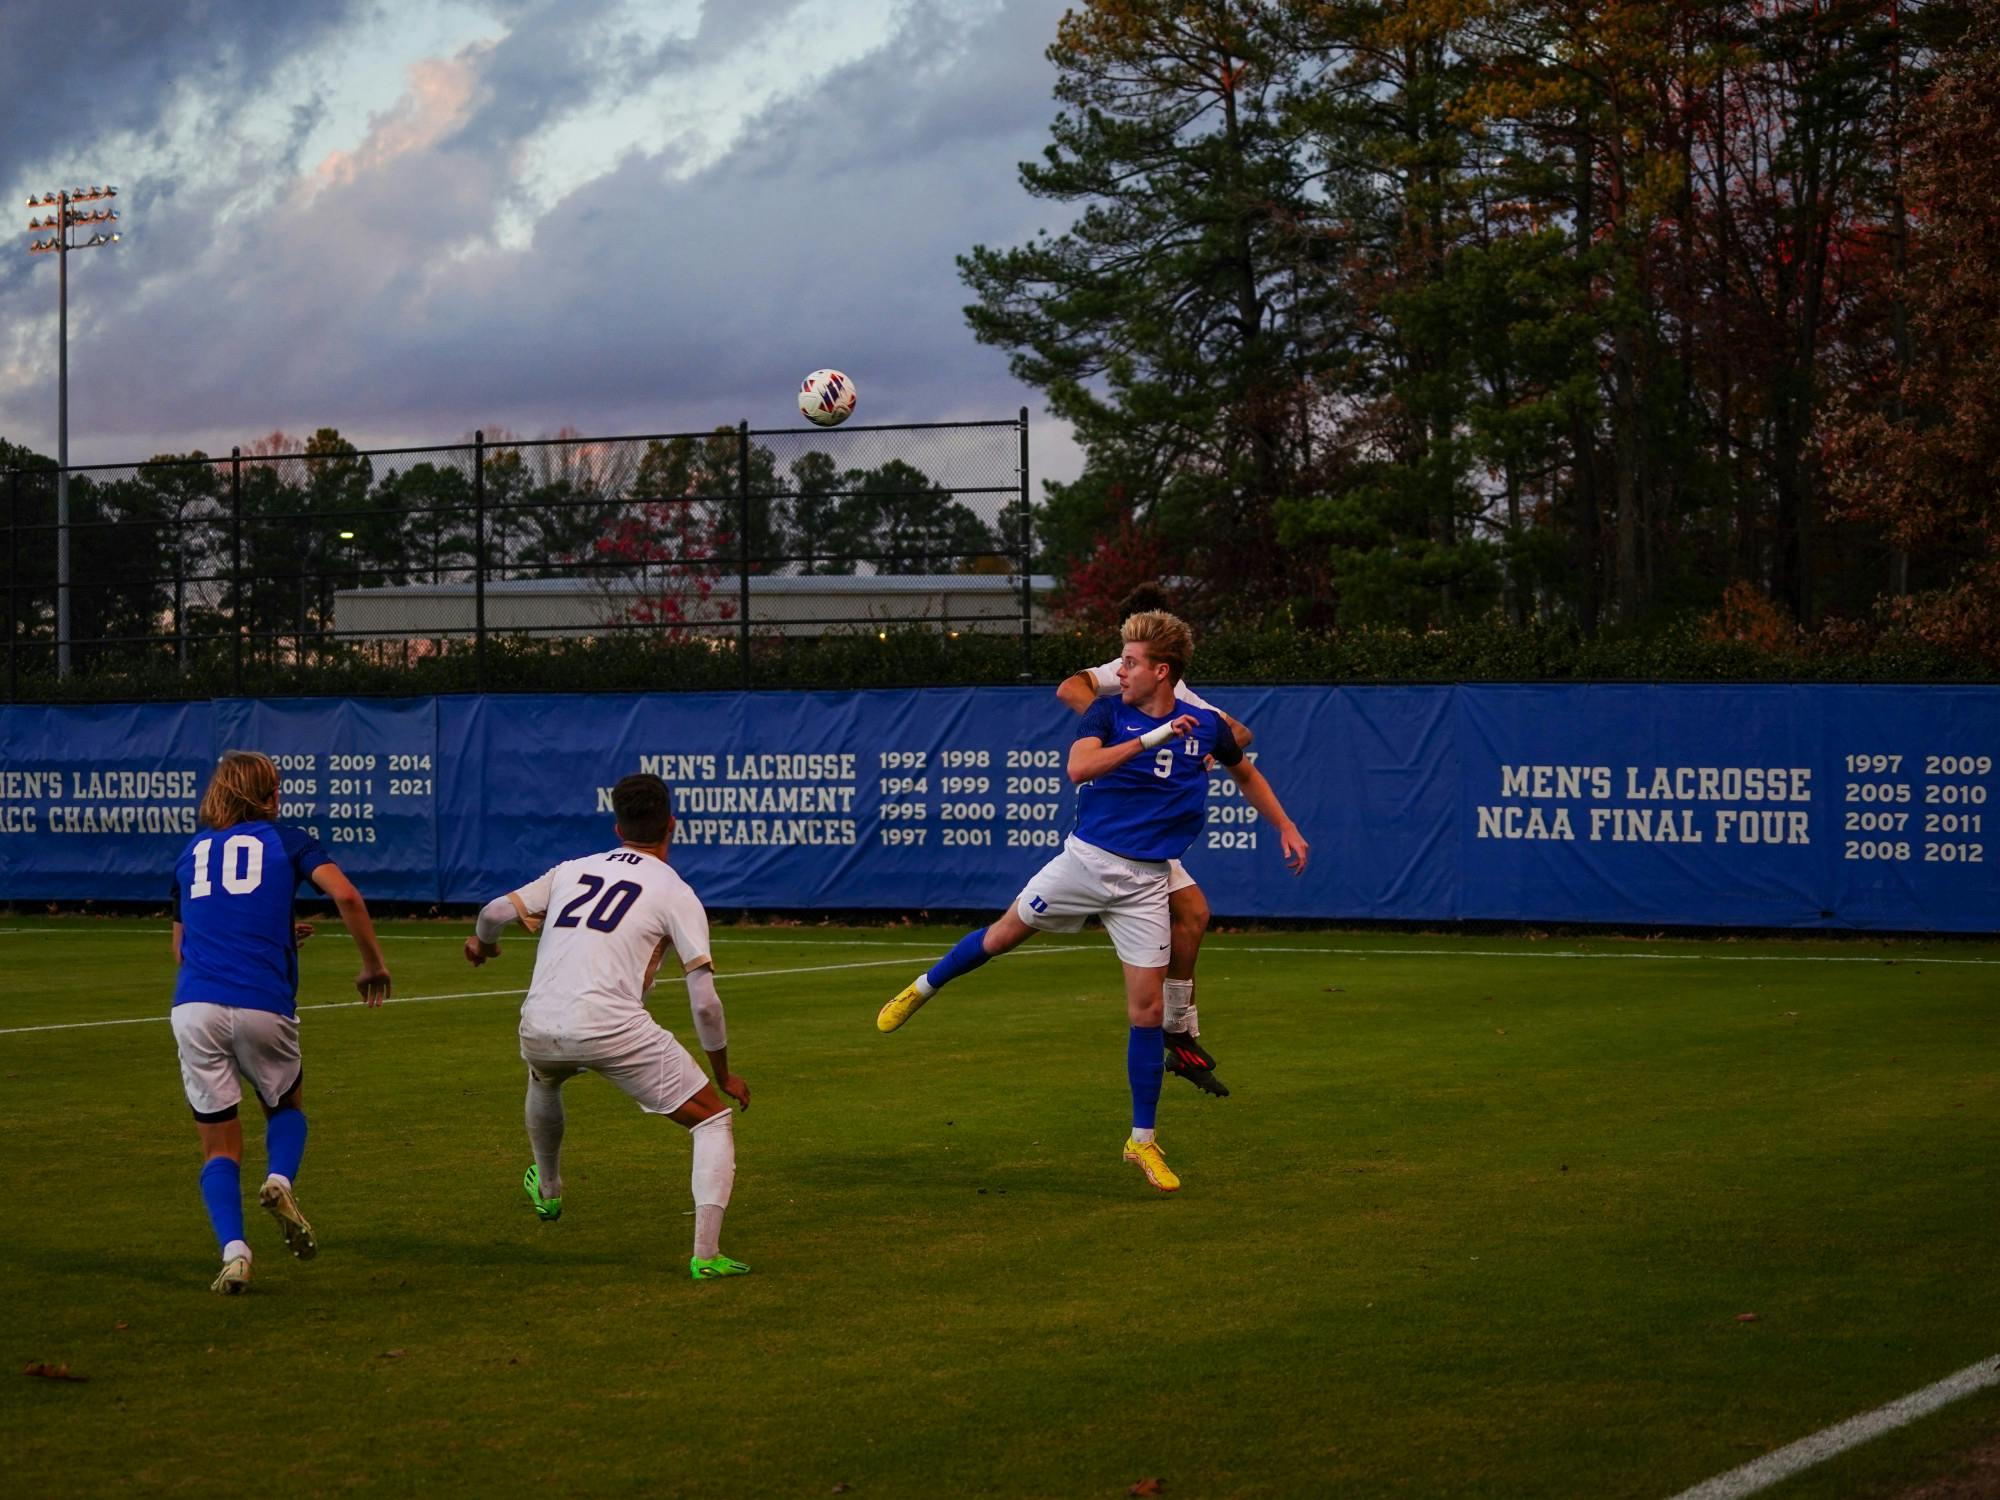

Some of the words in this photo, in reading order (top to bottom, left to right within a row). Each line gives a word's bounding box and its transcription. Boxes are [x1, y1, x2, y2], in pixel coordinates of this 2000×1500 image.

[329, 754, 376, 771] 2009
[388, 754, 431, 771] 2014
[640, 754, 717, 780] MEN'S
[726, 754, 856, 780] LACROSSE
[879, 752, 928, 769] 1992
[941, 751, 991, 768] 1998
[1006, 751, 1061, 768] 2002
[1153, 748, 1174, 778] 9
[1845, 754, 1903, 773] 1997
[1925, 756, 1993, 775] 2009
[72, 771, 197, 799] LACROSSE
[278, 779, 317, 795] 005
[330, 779, 372, 795] 2011
[389, 779, 432, 795] 2021
[879, 777, 928, 795] 1994
[941, 777, 990, 794] 1999
[1006, 777, 1061, 794] 2005
[1502, 765, 1611, 799] MEN'S
[1626, 767, 1812, 801] LACROSSE
[1845, 783, 1912, 803] 2005
[1925, 785, 1988, 804] 2010
[674, 786, 856, 812] TOURNAMENT
[48, 806, 197, 834] CHAMPIONS
[277, 802, 316, 819] 007
[329, 803, 374, 819] 2012
[879, 803, 927, 820] 1995
[940, 803, 996, 820] 2000
[1005, 803, 1059, 820] 2007
[1207, 805, 1259, 824] 2019
[671, 819, 857, 845] APPEARANCES
[1477, 806, 1576, 840] NCAA
[1590, 809, 1703, 842] FINAL
[1715, 810, 1811, 844] FOUR
[1845, 811, 1910, 831] 2007
[1924, 814, 1982, 833] 2011
[331, 826, 377, 842] 2013
[880, 828, 928, 846] 1997
[942, 829, 992, 846] 2001
[1007, 829, 1061, 847] 2008
[1207, 831, 1257, 849] 2021
[606, 852, 644, 866] FIU
[1844, 841, 1912, 860] 2008
[1924, 843, 1984, 862] 2012
[190, 834, 264, 900] 10
[553, 872, 643, 934] 20
